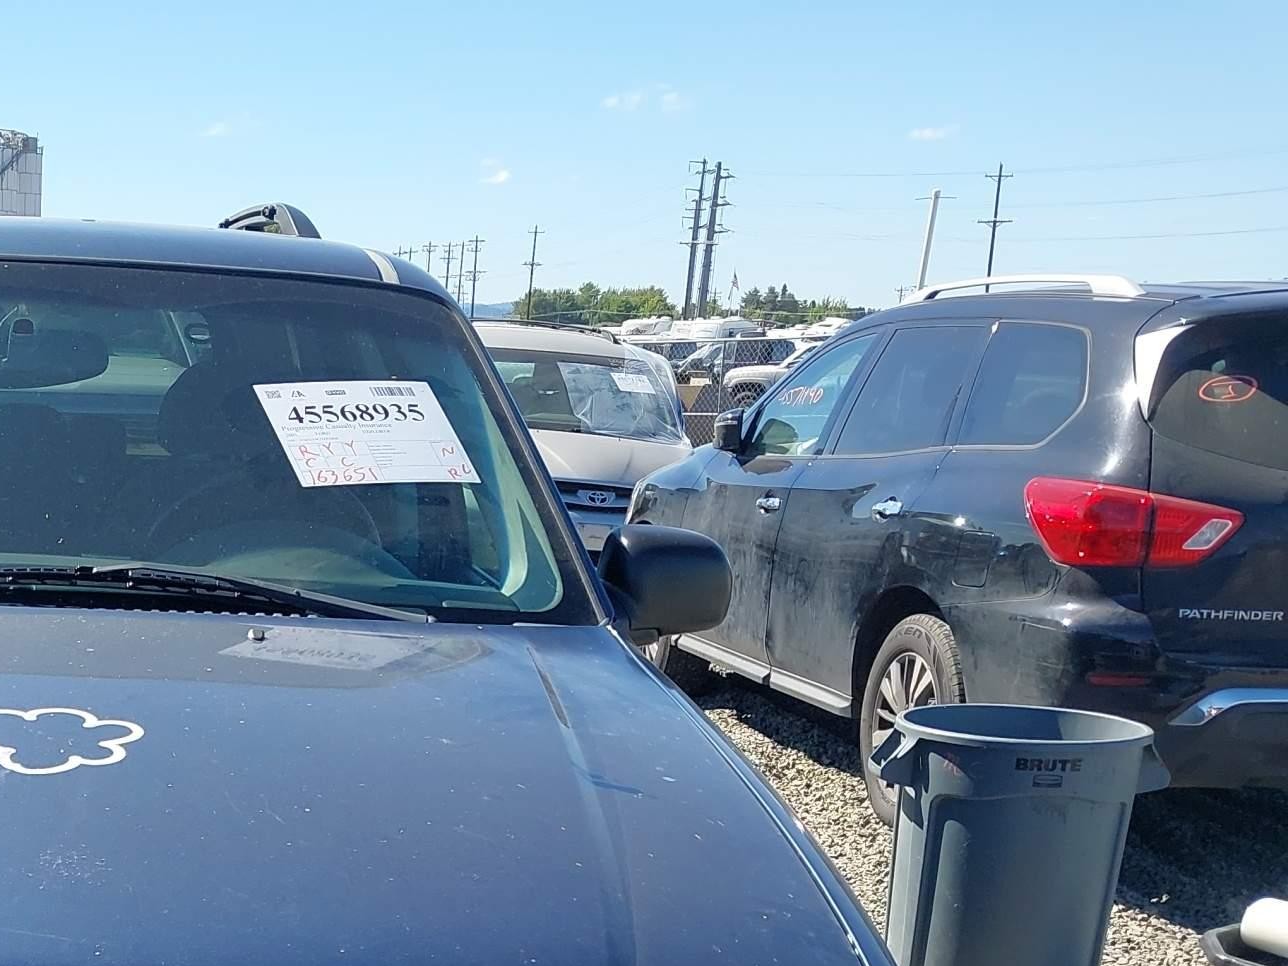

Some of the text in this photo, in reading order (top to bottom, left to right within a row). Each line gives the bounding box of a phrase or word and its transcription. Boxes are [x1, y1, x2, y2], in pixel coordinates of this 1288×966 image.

[288, 403, 425, 423] 45568935
[322, 442, 335, 456] Y
[345, 440, 357, 456] Y
[309, 466, 379, 485] 163651
[1178, 608, 1284, 621] PATHFINDER
[1015, 757, 1082, 772] BRUTE
